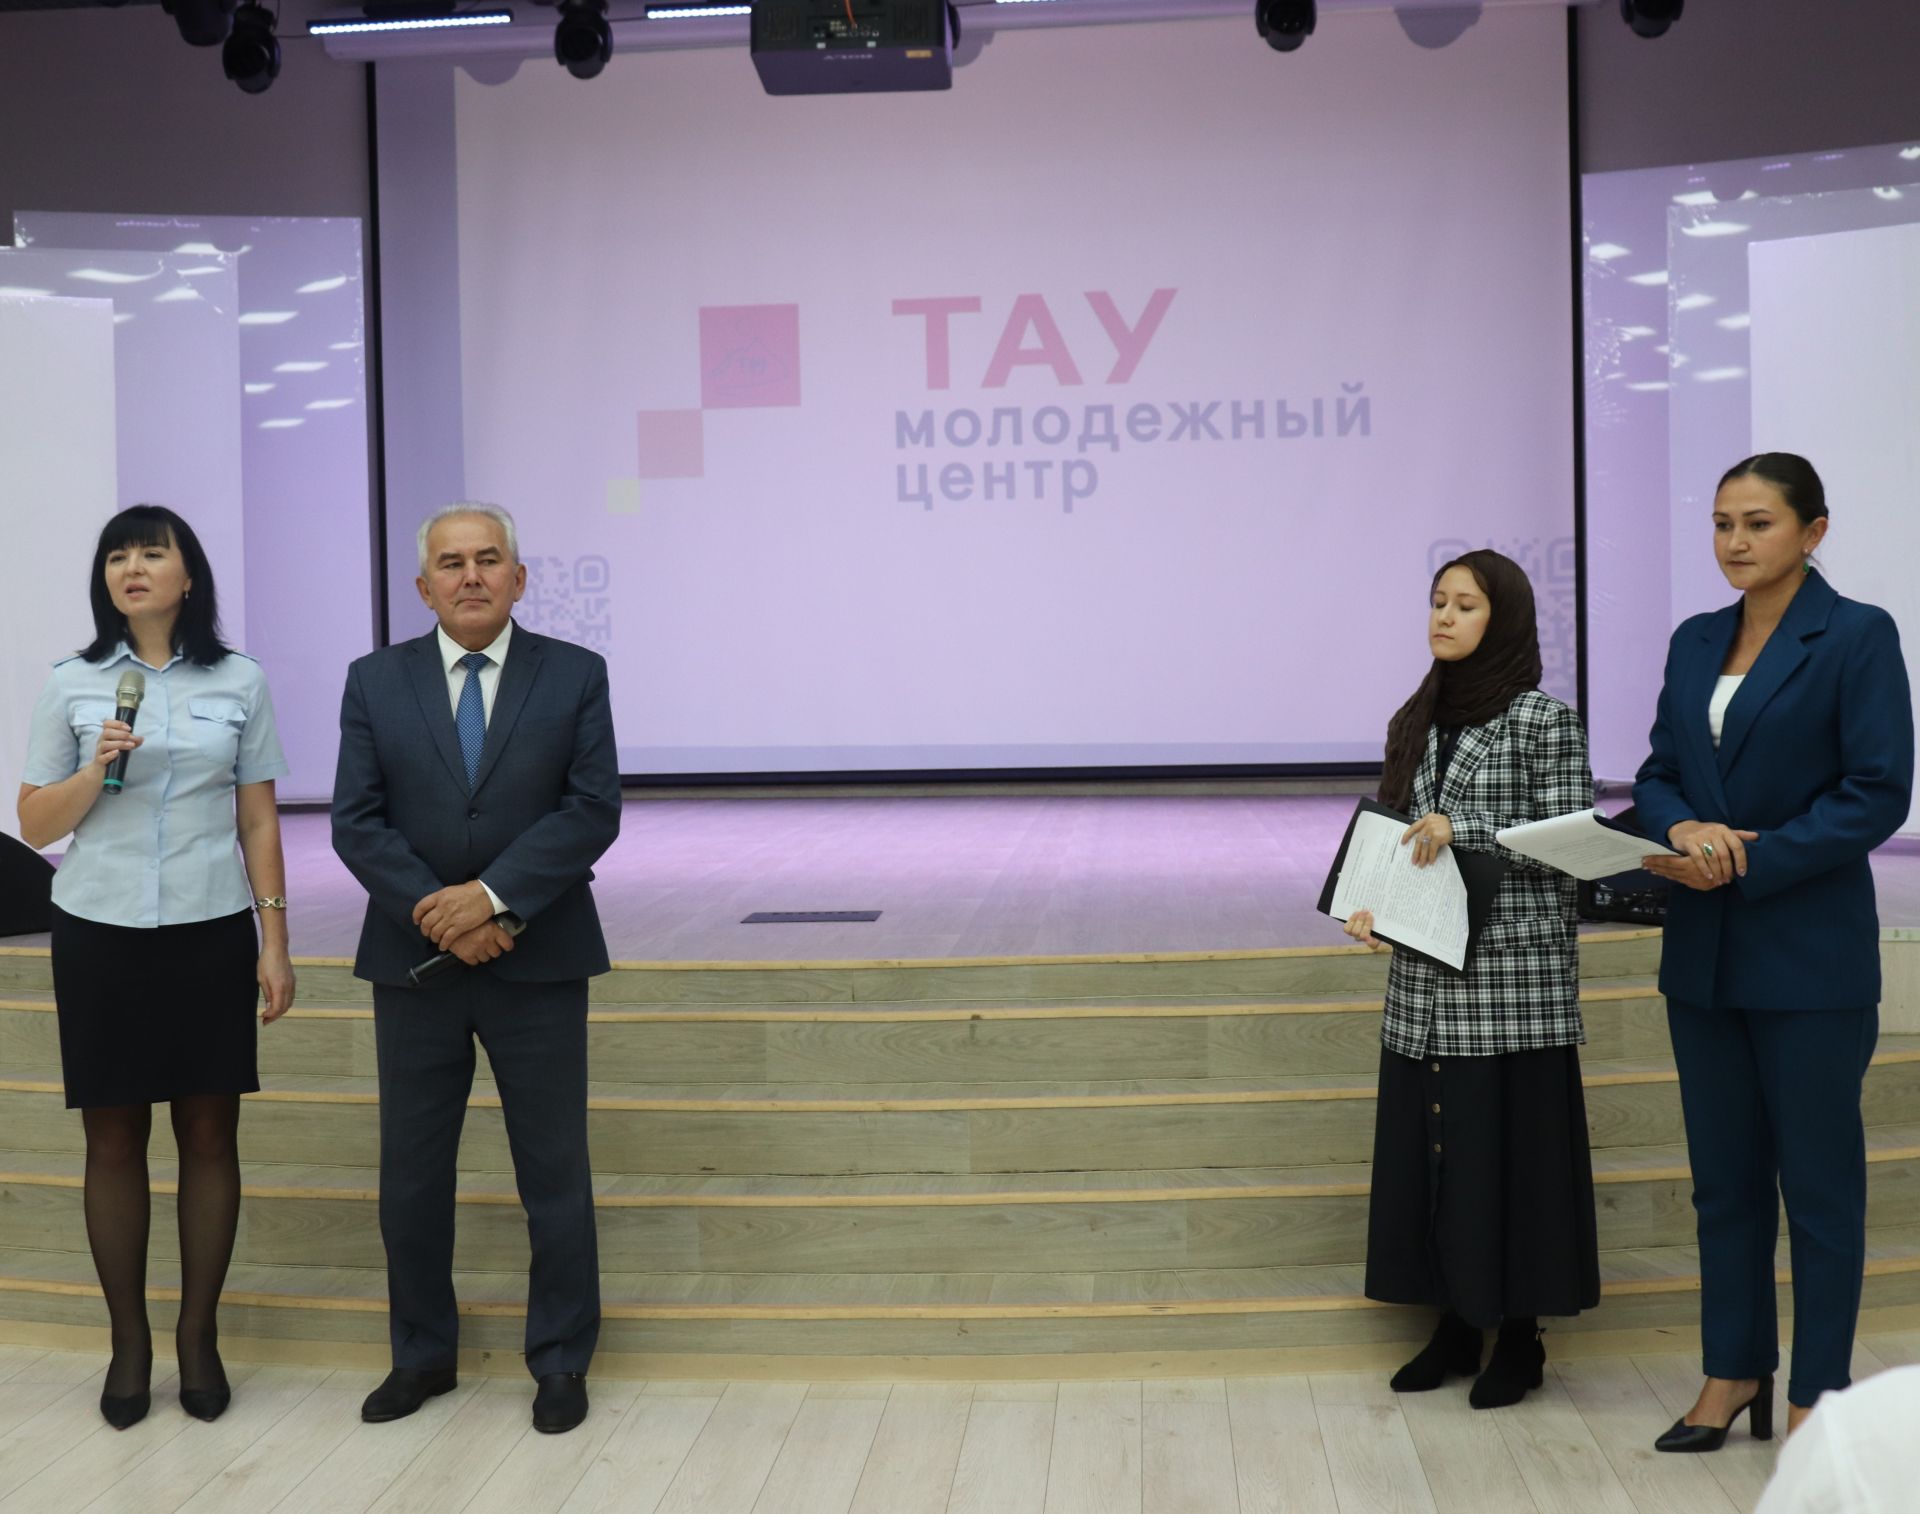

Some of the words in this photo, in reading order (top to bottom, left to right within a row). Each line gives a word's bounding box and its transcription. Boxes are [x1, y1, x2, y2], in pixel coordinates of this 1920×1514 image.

[891, 288, 1178, 390] ТАУ
[894, 382, 1371, 453] молодежный
[896, 459, 1098, 514] центр
